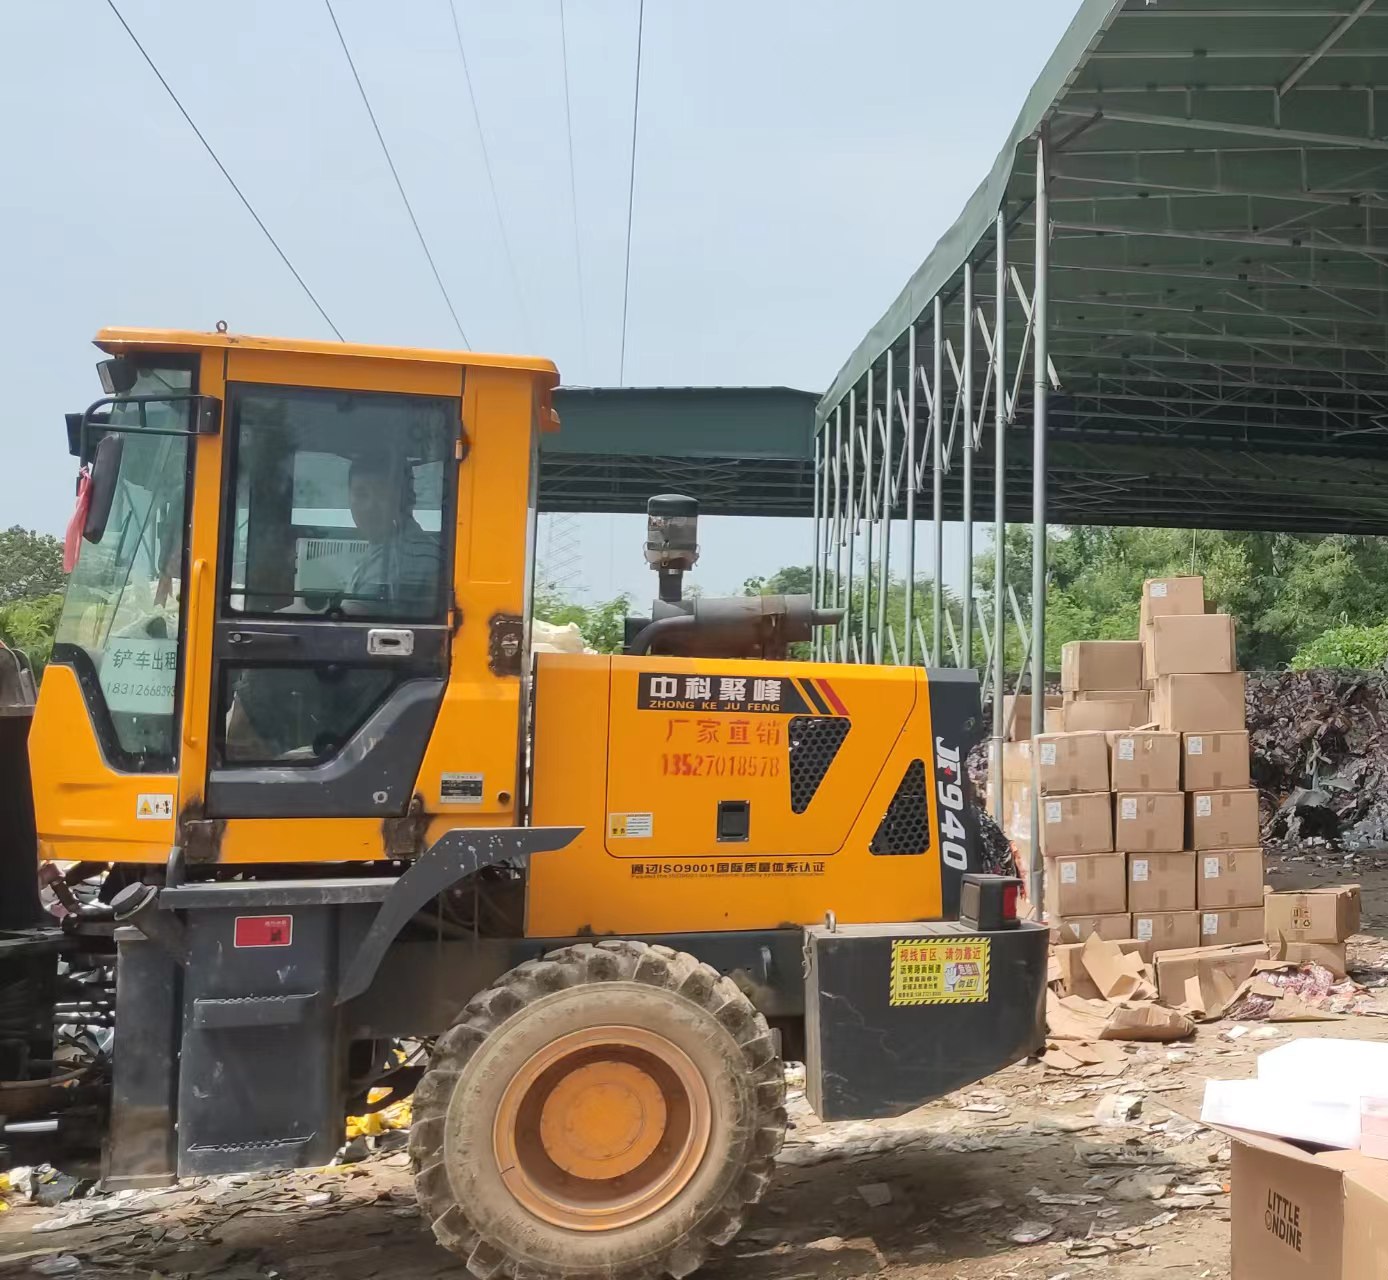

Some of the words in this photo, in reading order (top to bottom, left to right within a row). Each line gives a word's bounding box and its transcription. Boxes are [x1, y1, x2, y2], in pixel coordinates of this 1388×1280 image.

[112, 648, 177, 671] 铲车出租
[649, 676, 782, 702] 中科聚峰
[649, 700, 695, 710] ZHONG
[702, 702, 717, 710] KE
[724, 702, 740, 711] JU
[747, 703, 780, 712] FENG
[666, 719, 782, 746] 厂家直销
[661, 753, 780, 777] 13527018578
[1267, 1187, 1301, 1227] LITTLE
[1264, 1210, 1302, 1253] ONDINE
